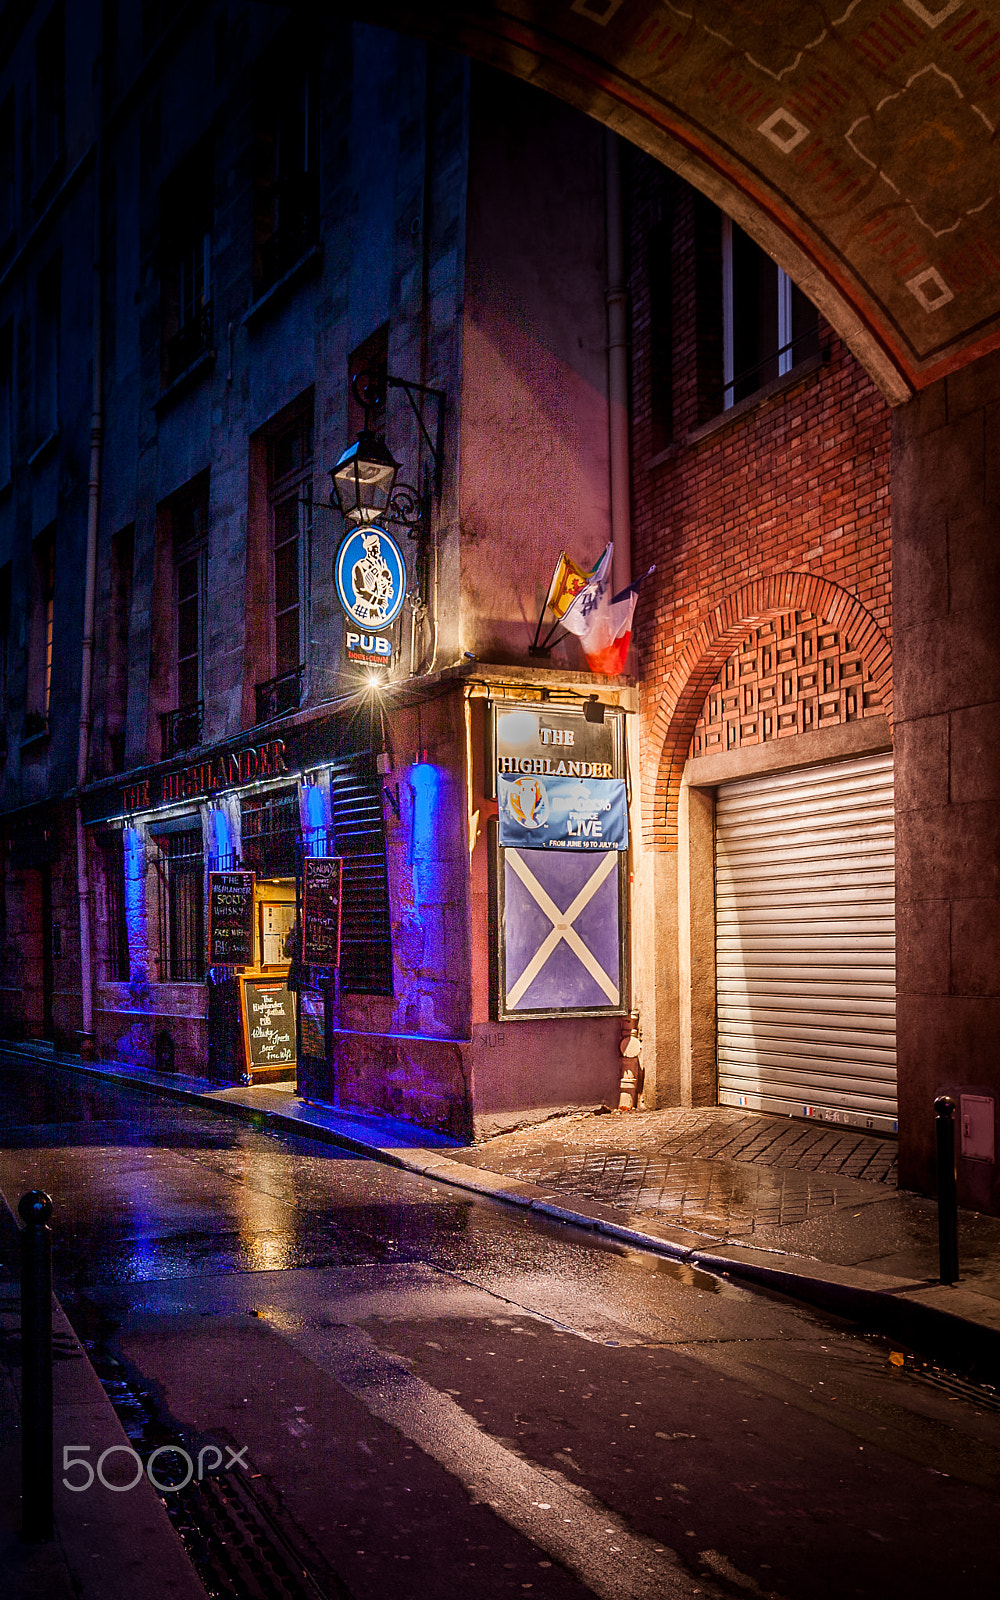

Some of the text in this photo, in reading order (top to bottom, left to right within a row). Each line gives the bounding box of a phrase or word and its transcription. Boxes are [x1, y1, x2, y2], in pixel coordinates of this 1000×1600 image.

[346, 632, 392, 657] PUB
[540, 728, 575, 746] THE
[119, 738, 289, 812] THE HIGHLANDER
[498, 757, 614, 778] HIGHLANDER
[567, 820, 603, 837] LIVE
[566, 840, 582, 848] JUNE
[221, 875, 240, 885] THE
[261, 995, 274, 1003] The
